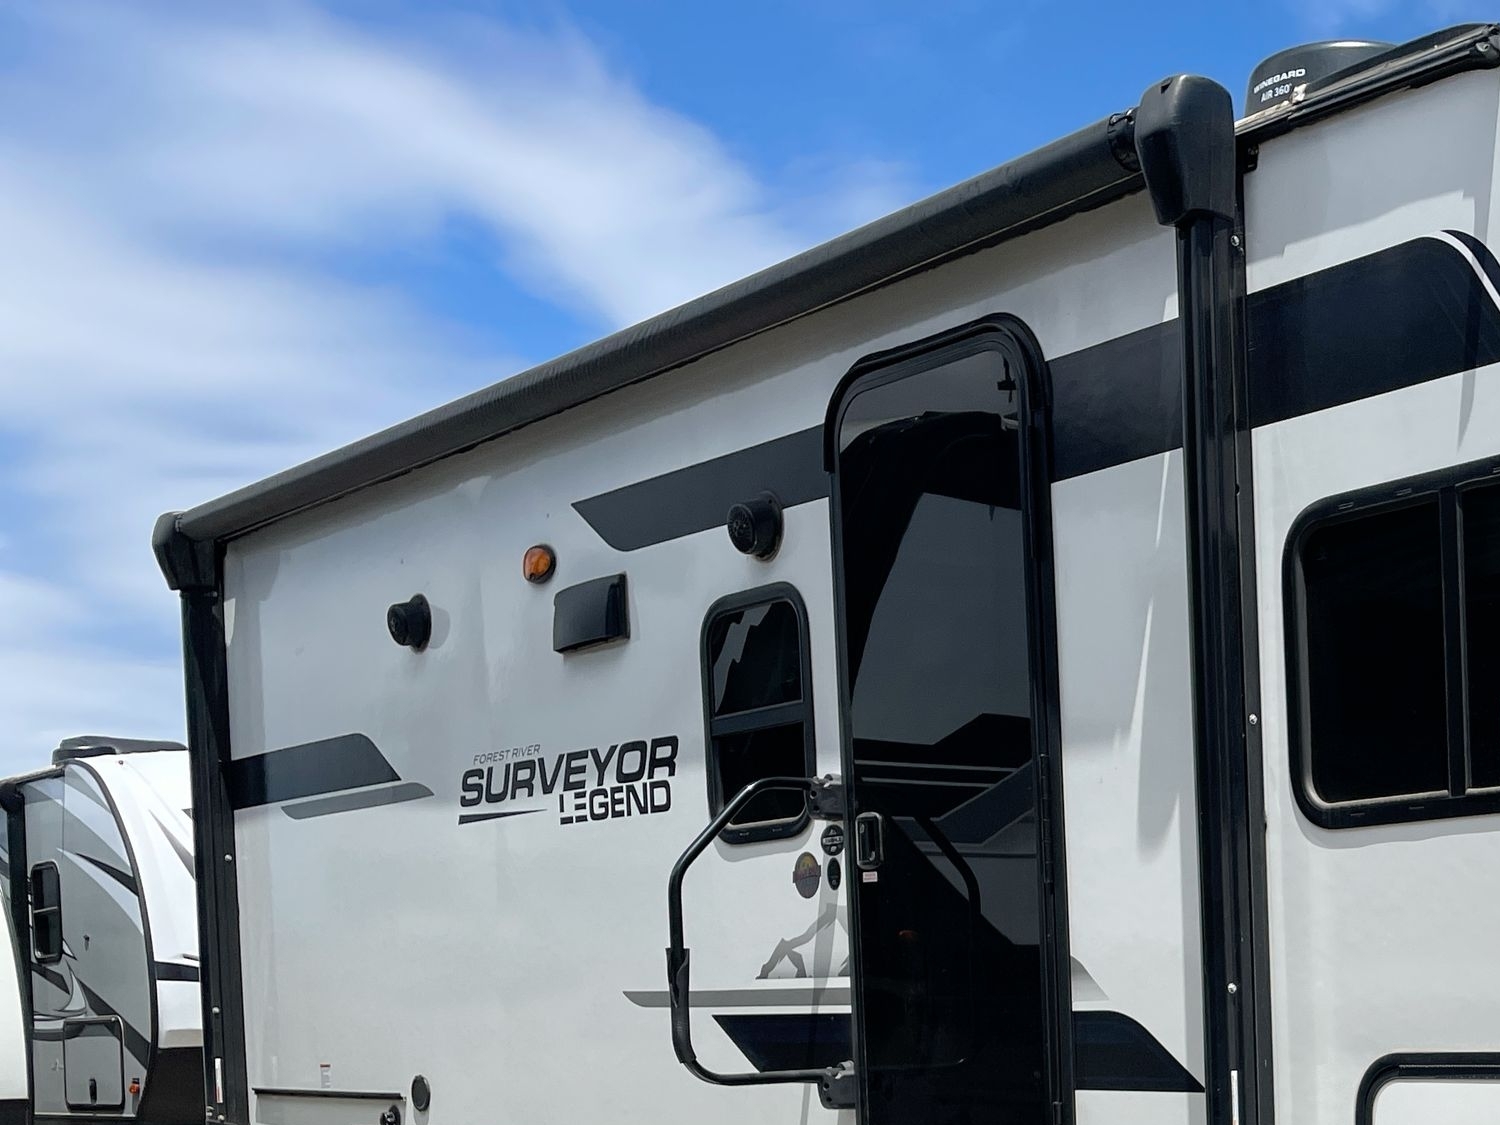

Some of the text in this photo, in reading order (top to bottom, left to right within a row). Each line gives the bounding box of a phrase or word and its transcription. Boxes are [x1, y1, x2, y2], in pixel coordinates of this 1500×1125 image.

[1254, 69, 1306, 94] WINEGARD
[1261, 89, 1274, 102] AIR
[473, 744, 541, 766] FOREST RIVER
[459, 735, 680, 808] SURVEYOR
[559, 779, 672, 825] LEGEND
